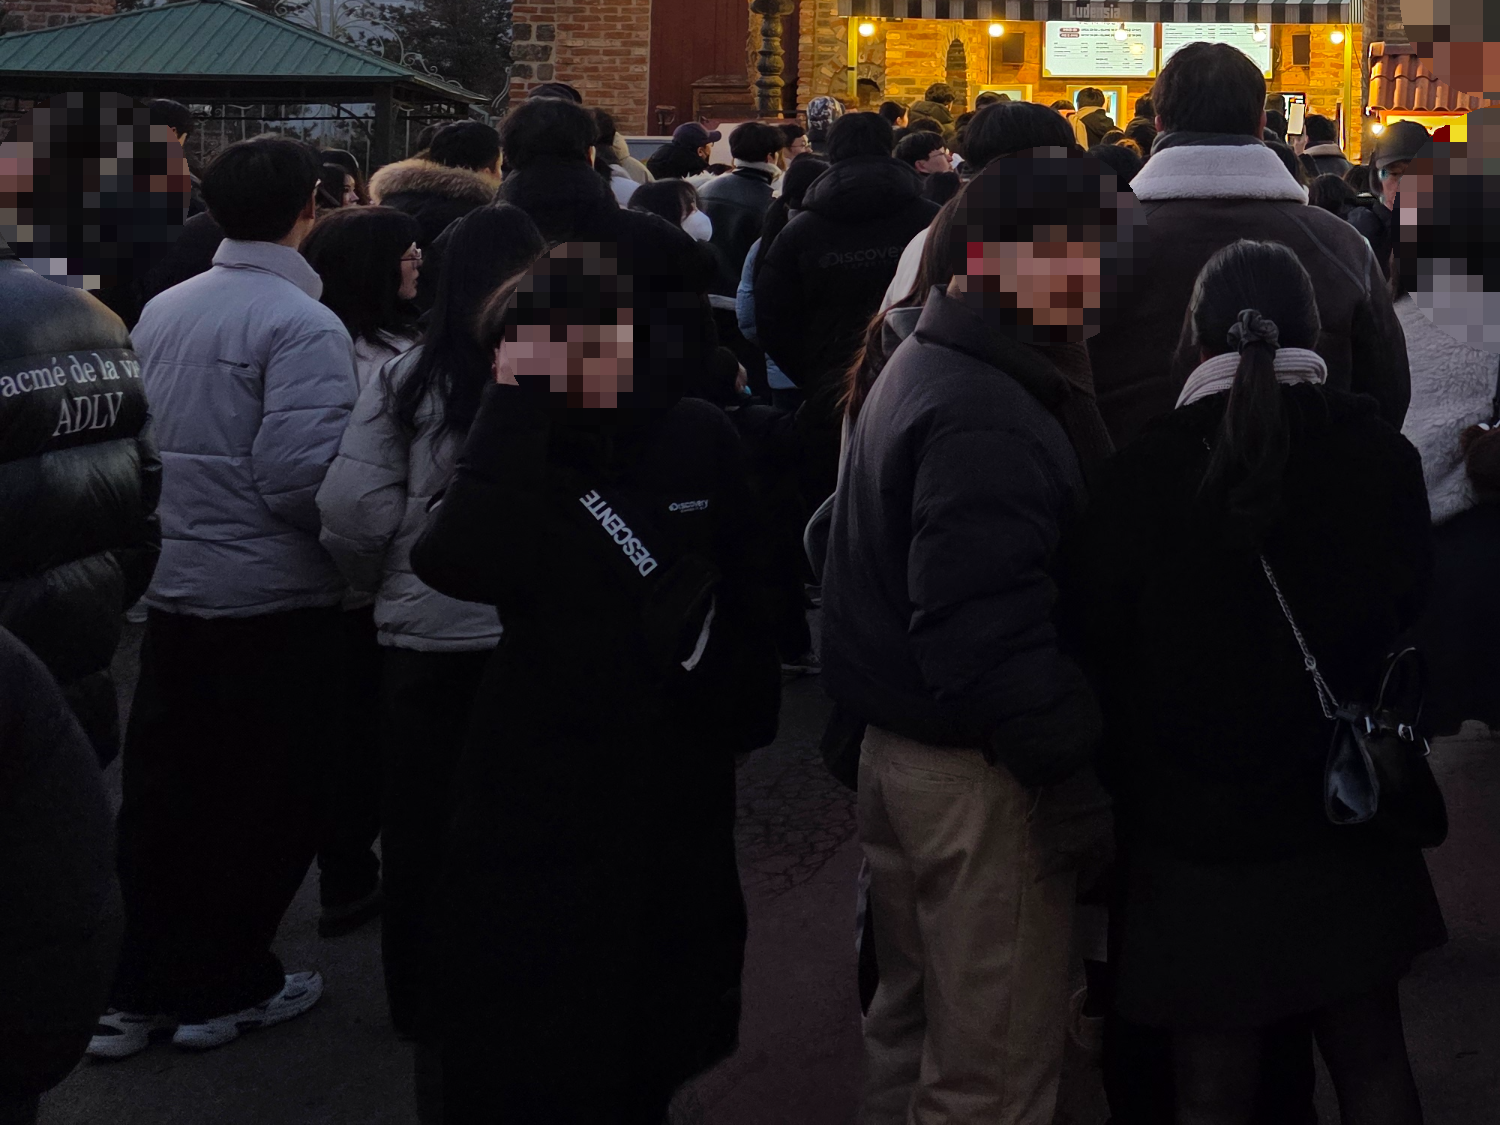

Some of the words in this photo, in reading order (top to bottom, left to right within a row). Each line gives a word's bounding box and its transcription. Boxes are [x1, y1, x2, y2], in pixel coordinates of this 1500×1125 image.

[1069, 2, 1121, 19] Ludensia
[0, 356, 67, 398] acmé
[68, 354, 97, 384] de
[91, 352, 121, 380] la
[51, 391, 124, 437] ADLV
[578, 489, 658, 577] DESCENTE
